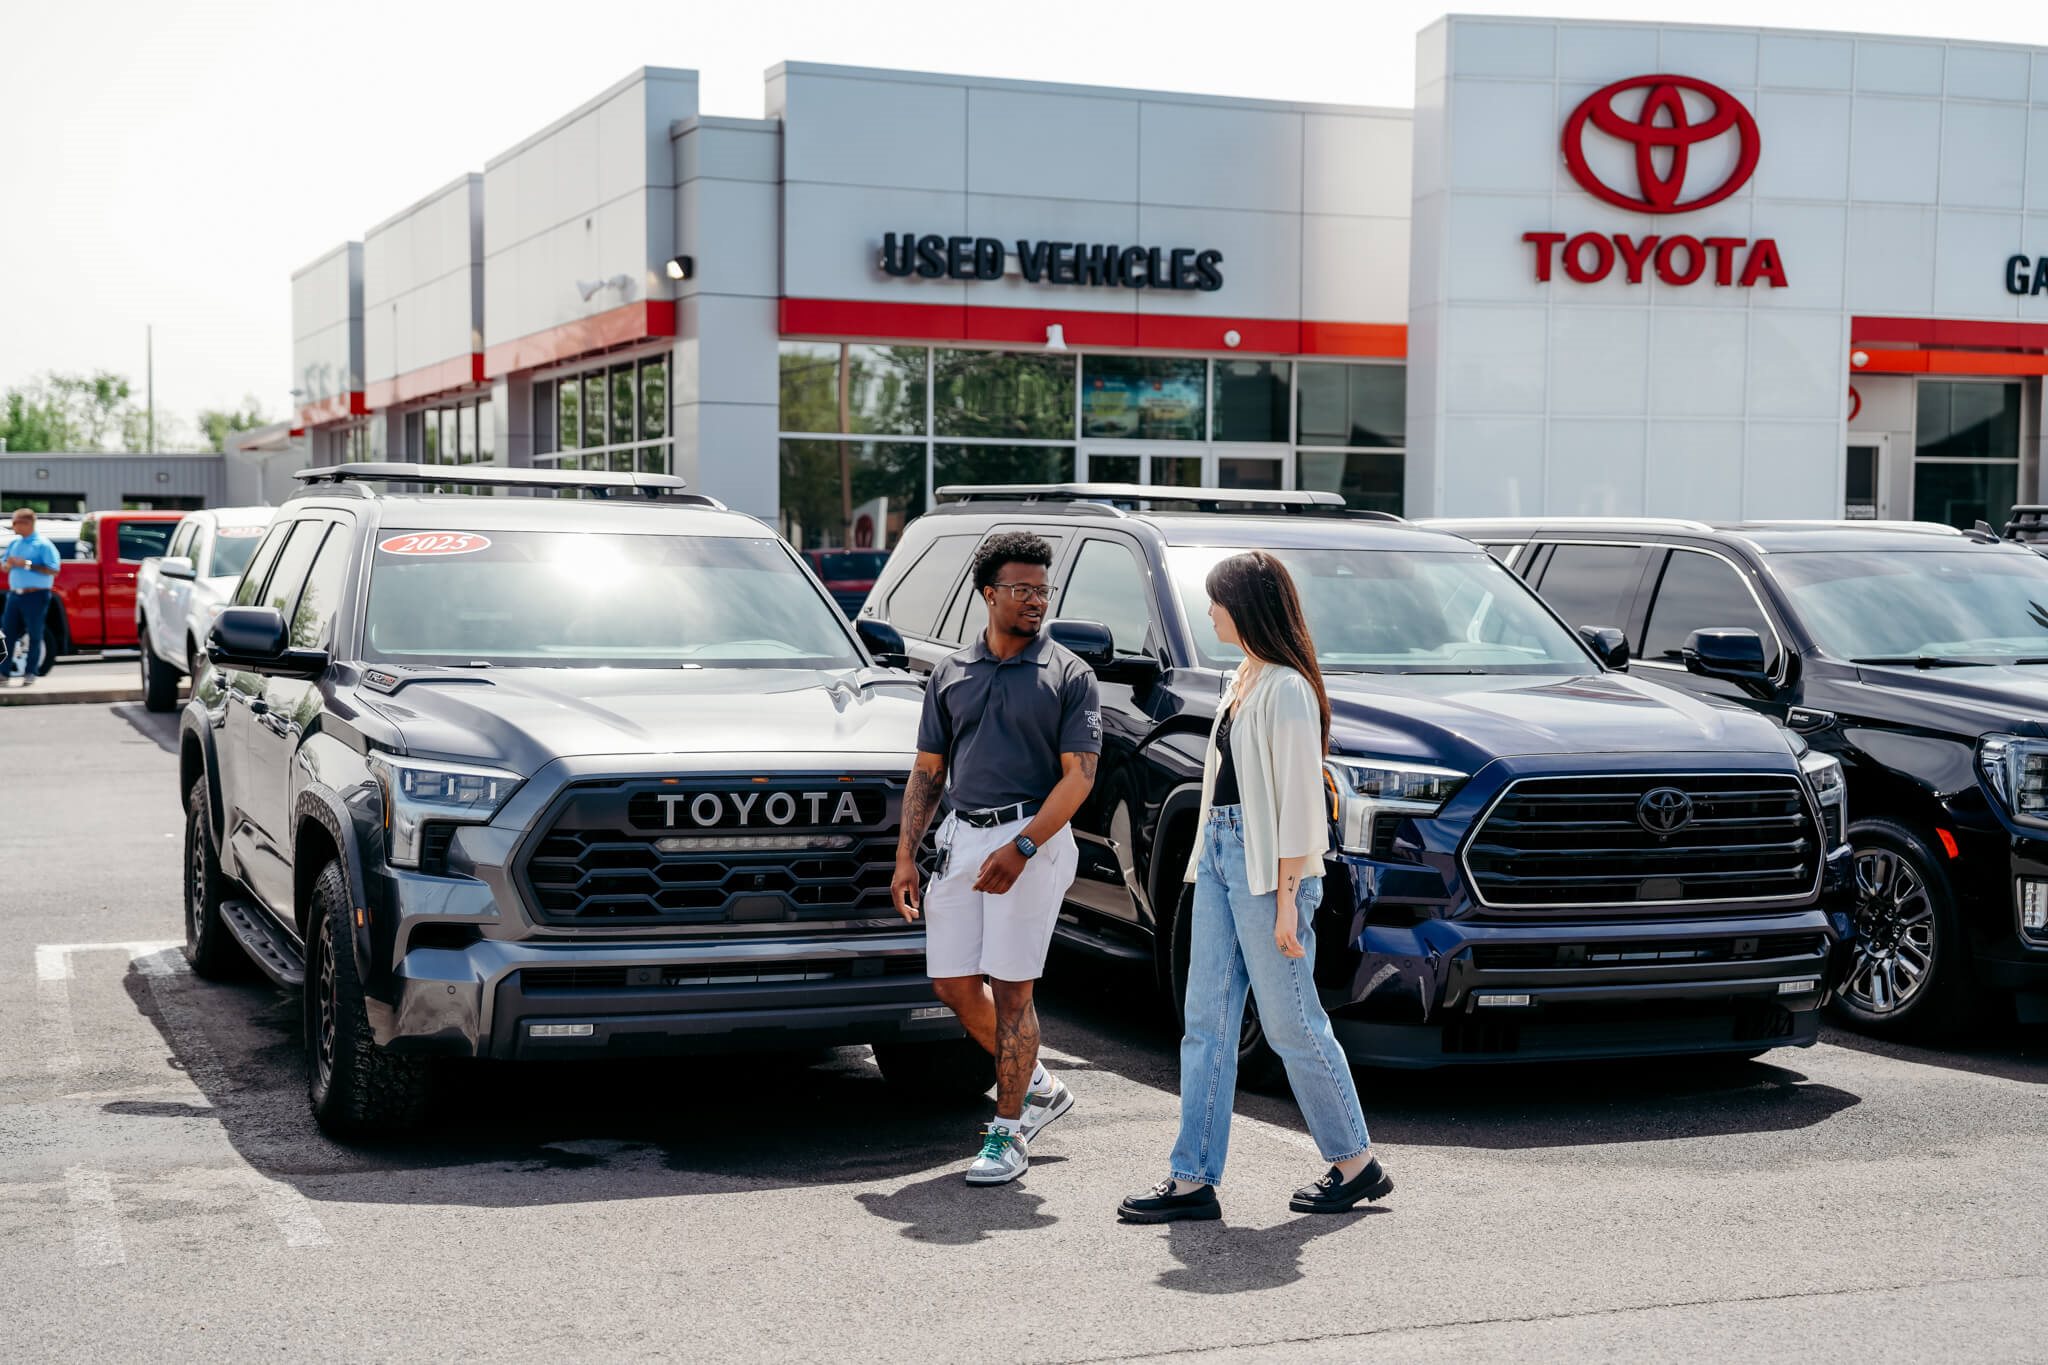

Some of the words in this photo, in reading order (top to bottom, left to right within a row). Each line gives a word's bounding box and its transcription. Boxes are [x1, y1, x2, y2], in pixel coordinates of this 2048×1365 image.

[883, 232, 1006, 281] USED
[1016, 240, 1223, 292] VEHICLES
[1522, 231, 1788, 288] TOYOTA
[397, 535, 474, 552] 2025
[657, 791, 862, 826] TOYOTA
